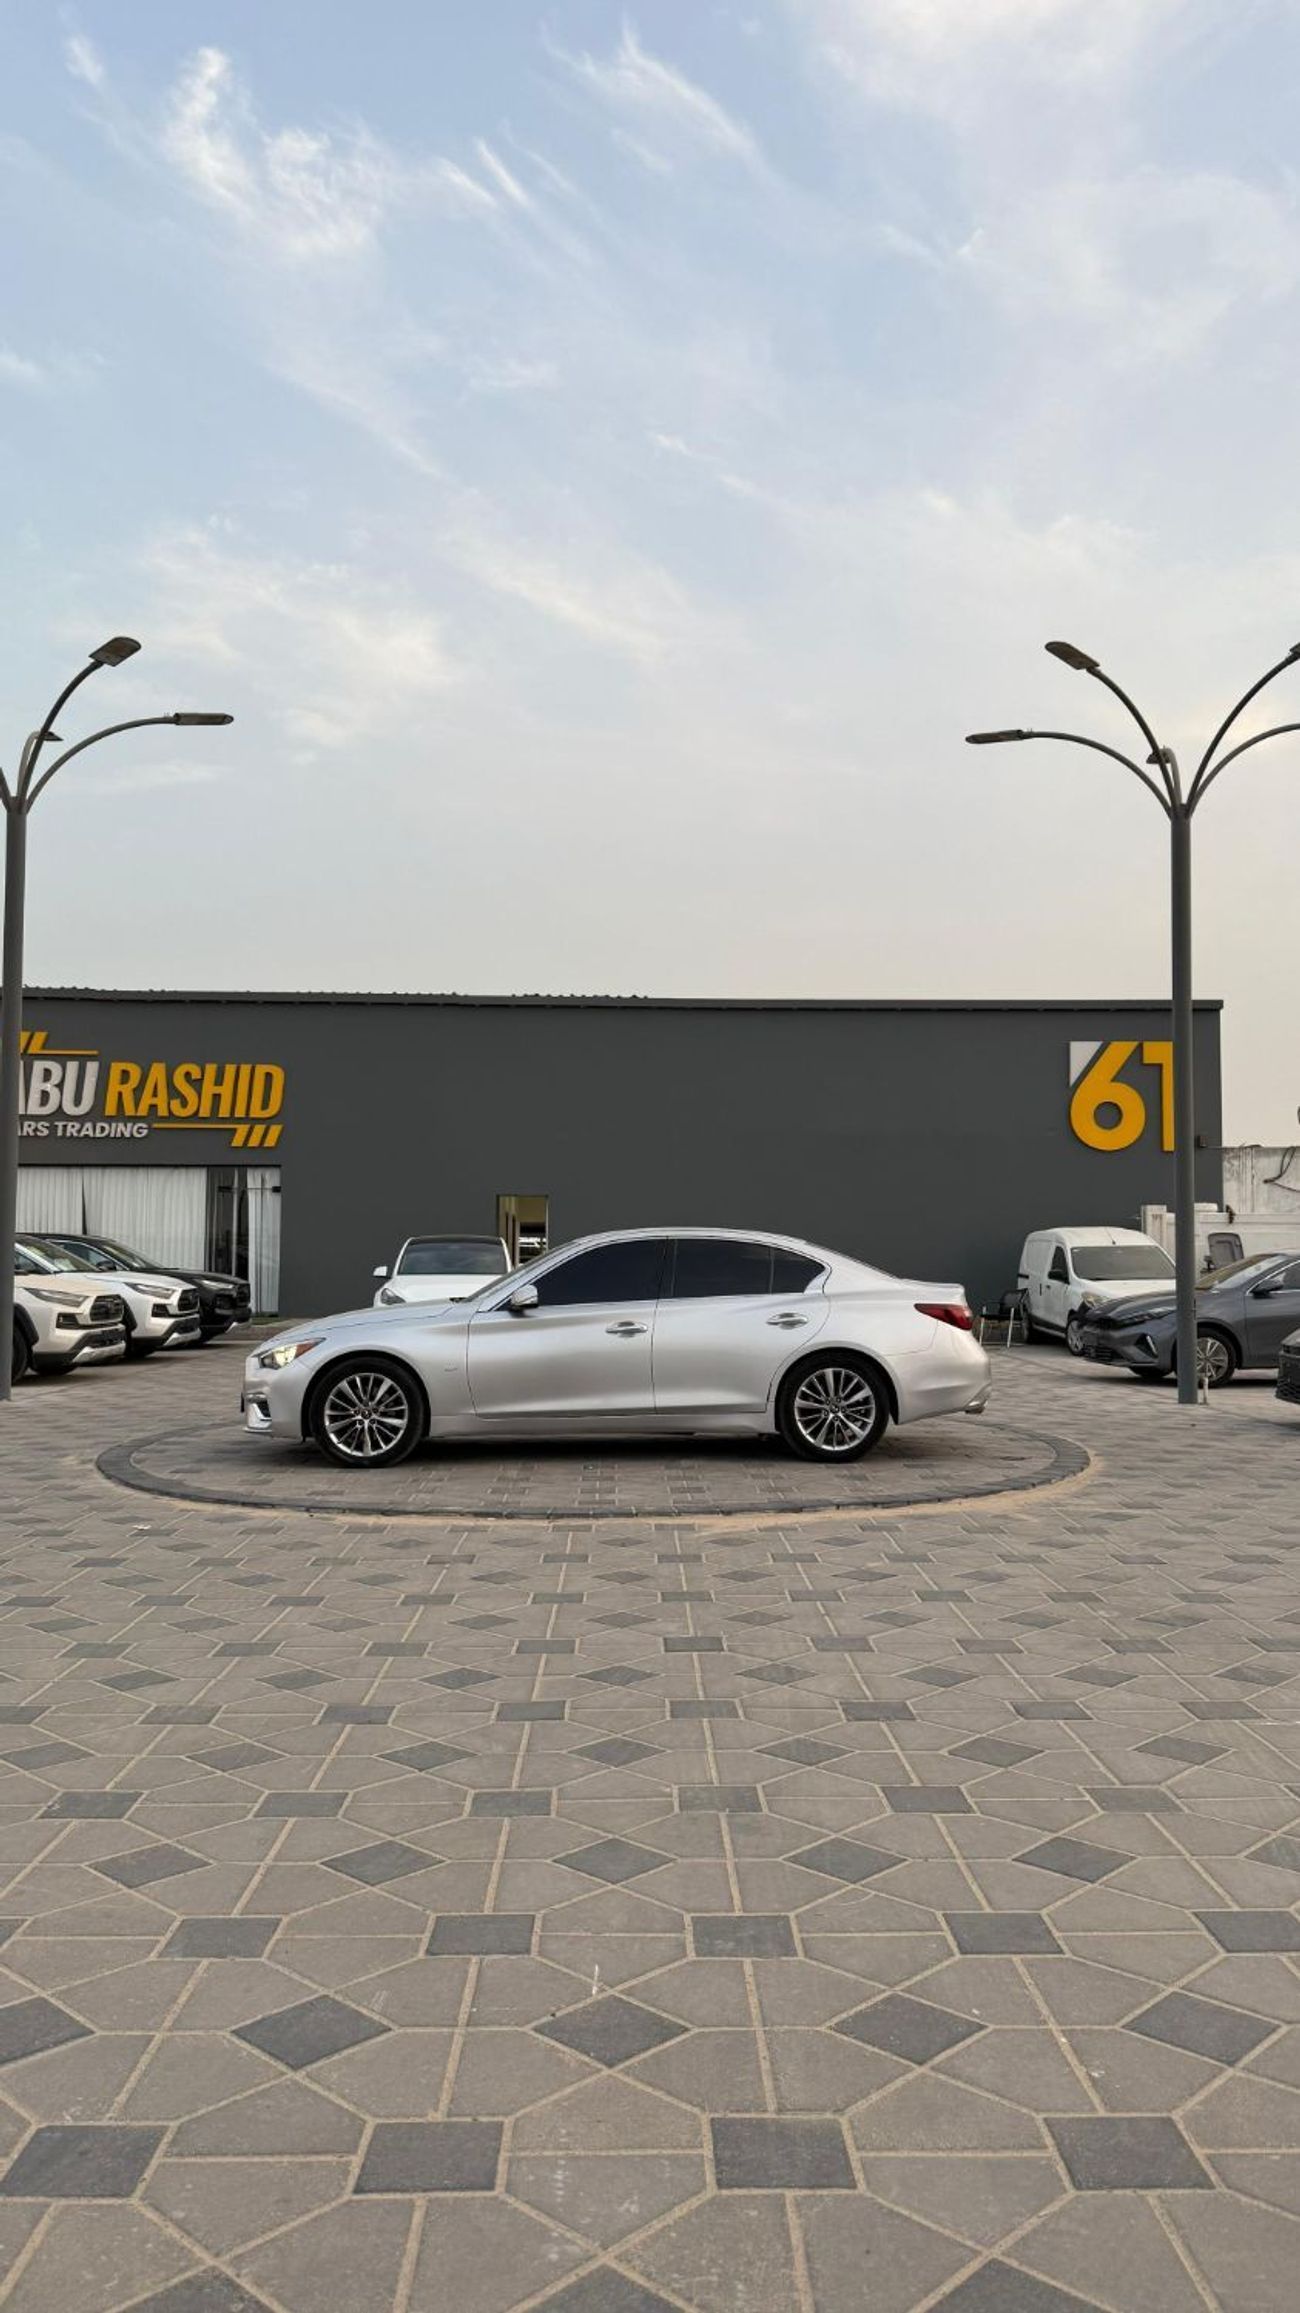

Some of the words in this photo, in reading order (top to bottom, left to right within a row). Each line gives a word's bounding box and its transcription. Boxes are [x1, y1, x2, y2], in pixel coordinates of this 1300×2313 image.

[104, 1062, 285, 1119] RASHID
[18, 1121, 50, 1137] RS
[54, 1121, 149, 1138] TRADING
